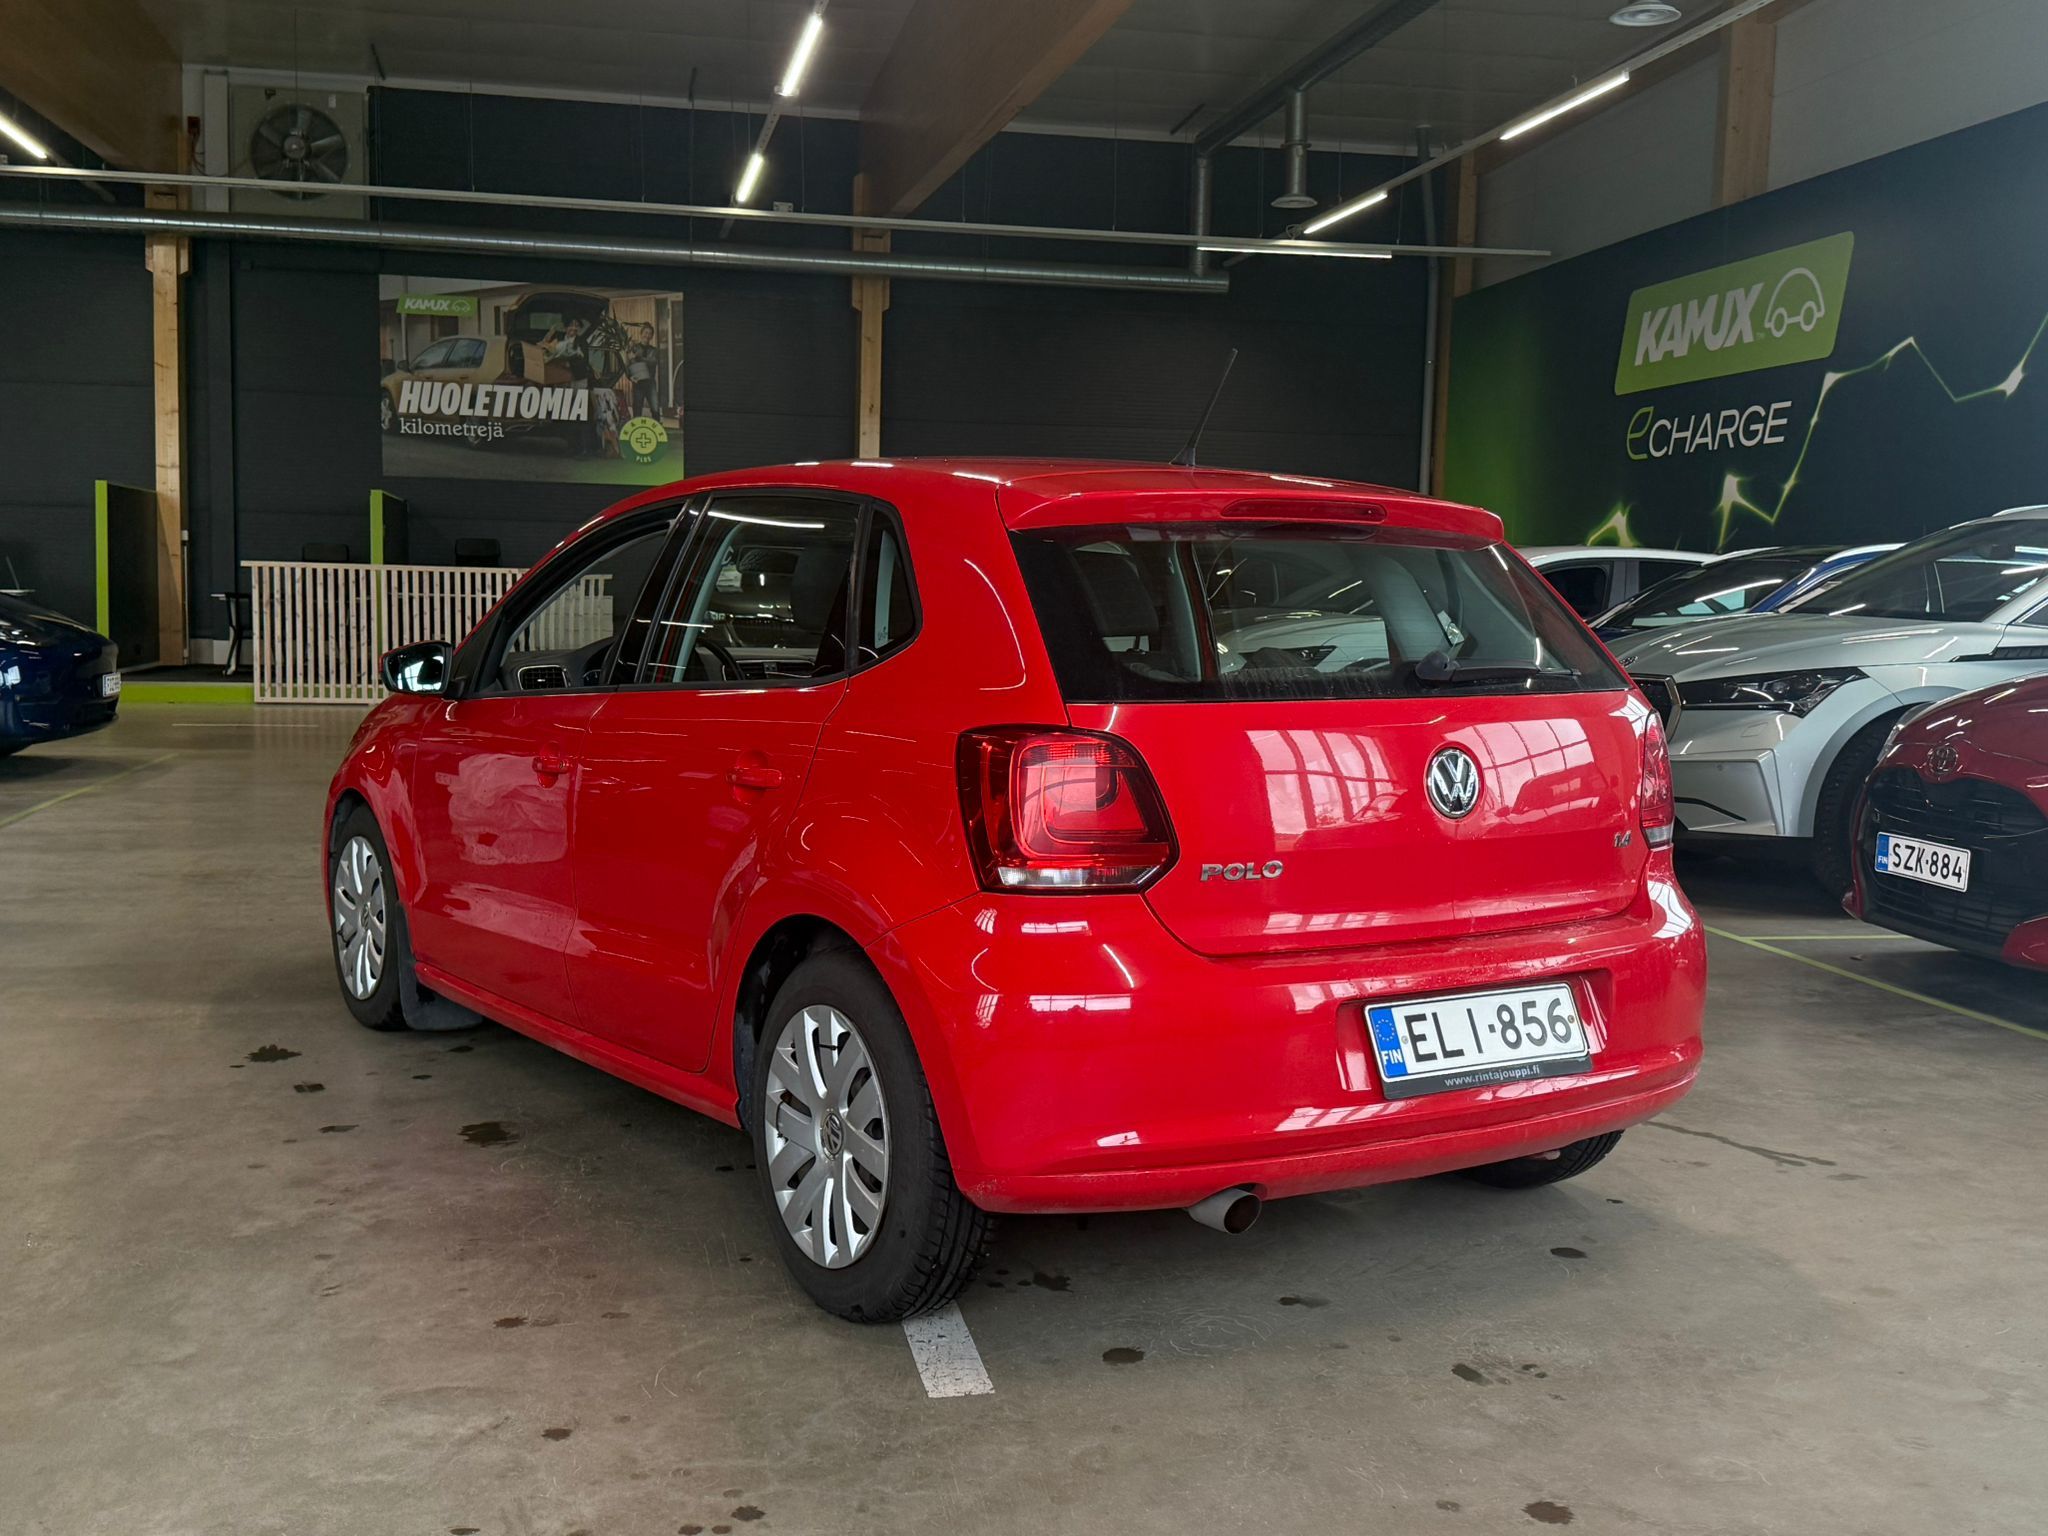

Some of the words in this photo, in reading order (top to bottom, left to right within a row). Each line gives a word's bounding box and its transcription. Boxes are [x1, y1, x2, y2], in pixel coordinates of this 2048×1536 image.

[404, 297, 450, 312] KAMUX
[1634, 282, 1764, 366] KAMUX
[399, 380, 589, 422] HUOLETTOMIA
[400, 418, 505, 442] kilometrejä
[1201, 860, 1283, 882] POLO
[1892, 842, 1962, 883] SZK-884
[1404, 998, 1572, 1062] ELI-856
[1381, 1049, 1403, 1065] FIN
[1445, 1064, 1540, 1087] www.rintajouppi.fi
